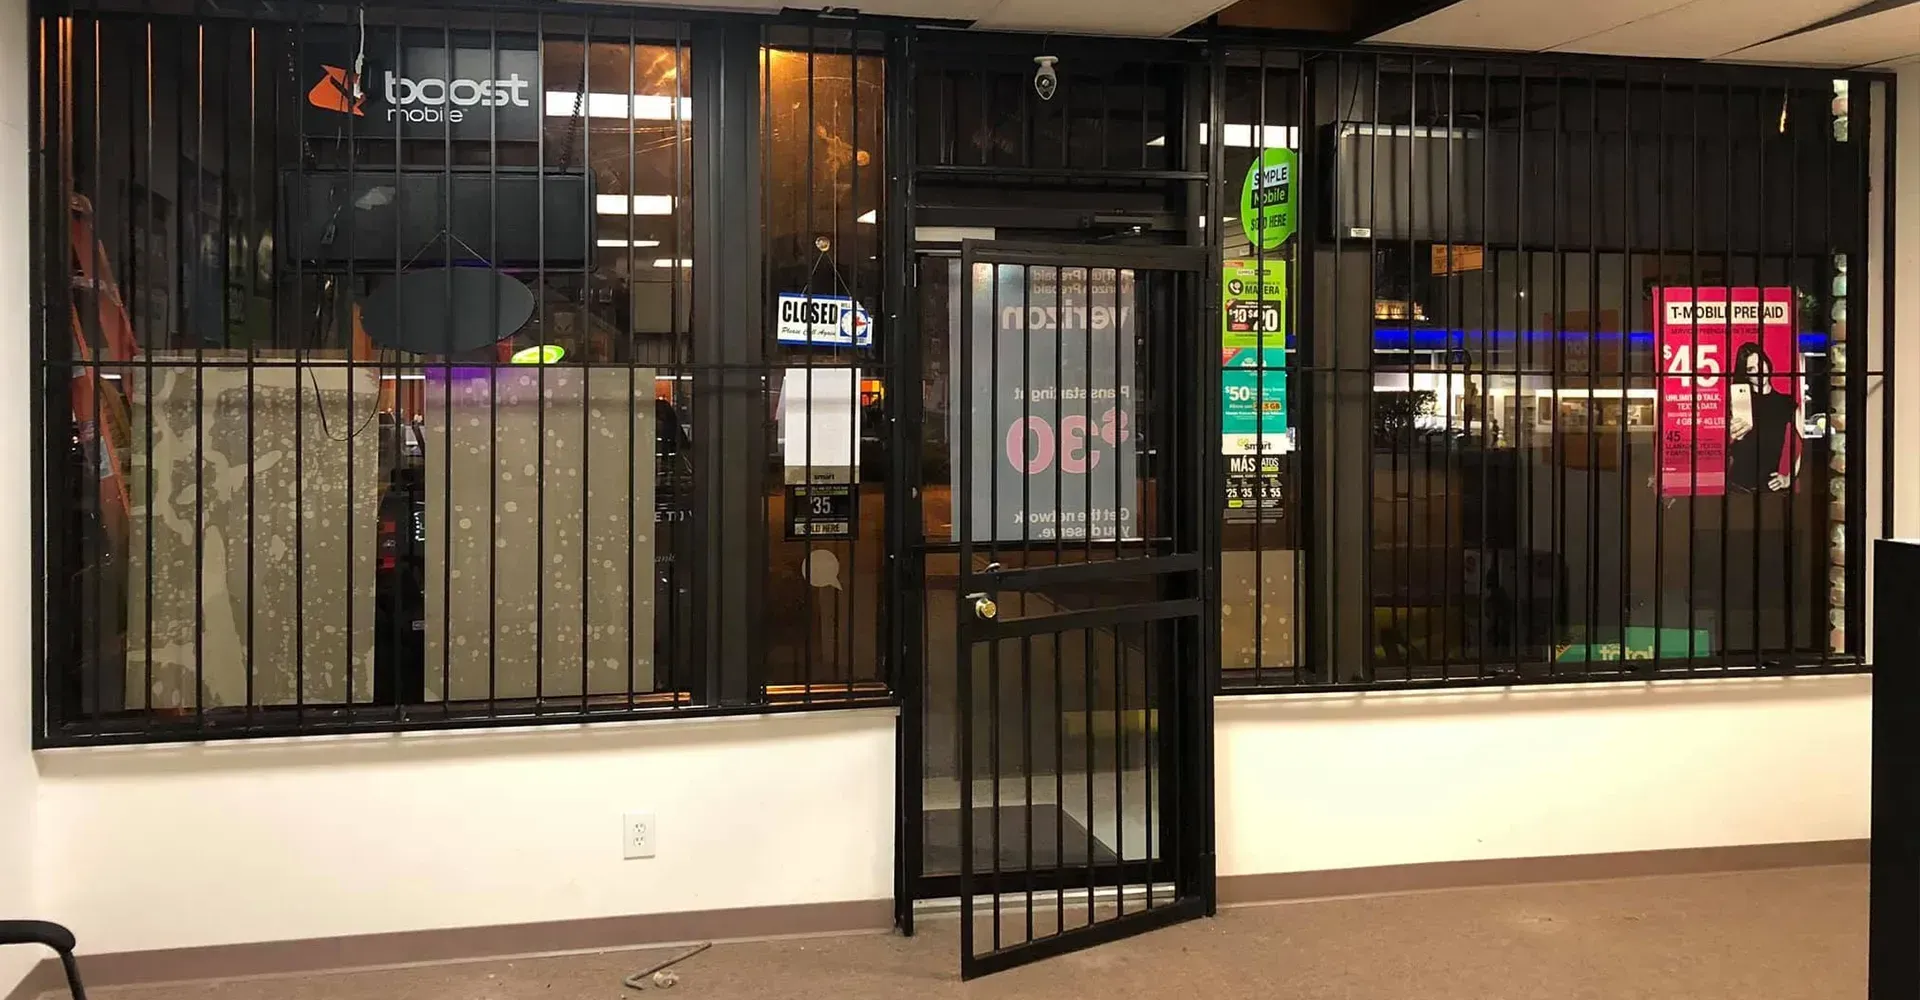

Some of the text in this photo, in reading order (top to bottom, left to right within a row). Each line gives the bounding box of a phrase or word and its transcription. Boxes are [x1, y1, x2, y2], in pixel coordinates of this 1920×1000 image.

[385, 71, 529, 107] boost
[387, 107, 463, 122] mobie
[1254, 167, 1287, 185] SMPLE
[1251, 213, 1286, 231] SOD HERE
[1245, 286, 1280, 295] MAERA
[782, 300, 838, 325] CLOSED
[1671, 306, 1783, 319] T-MOBIL PREAID
[782, 326, 836, 337] Please Cll Again
[1663, 344, 1720, 387] $45
[1225, 386, 1249, 401] $50
[1231, 455, 1279, 472] MÁS ATOS
[801, 524, 823, 534] SLD
